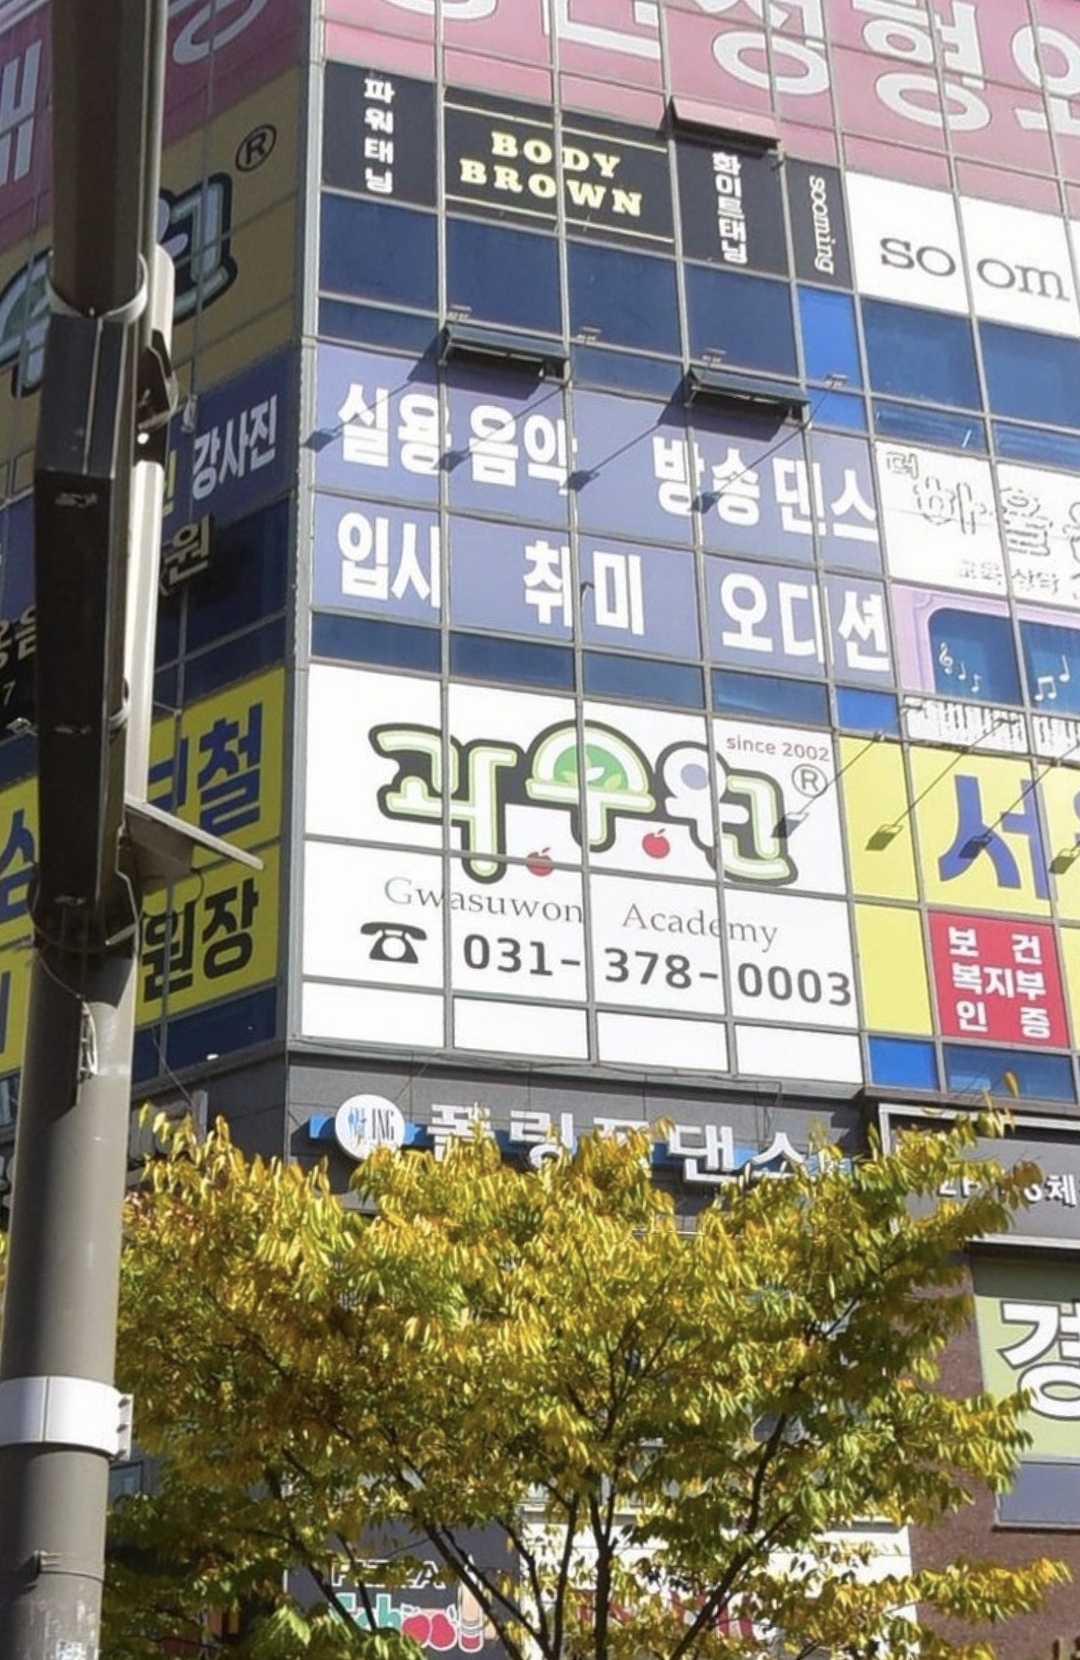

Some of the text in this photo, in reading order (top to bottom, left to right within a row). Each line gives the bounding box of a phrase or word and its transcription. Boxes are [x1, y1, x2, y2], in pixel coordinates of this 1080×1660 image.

[363, 77, 396, 195] 파워태닝
[490, 130, 621, 179] BODY
[459, 157, 643, 218] BROWN
[191, 394, 278, 501] 강사진
[337, 511, 441, 609] 입시
[522, 539, 646, 637] 취미
[719, 572, 891, 673] 오디션
[726, 734, 831, 763] since 2002
[368, 717, 799, 886] 과수원
[141, 878, 259, 1004] 원장
[384, 876, 779, 953] Gwasuwon Academy
[952, 959, 1047, 1001] 복지부
